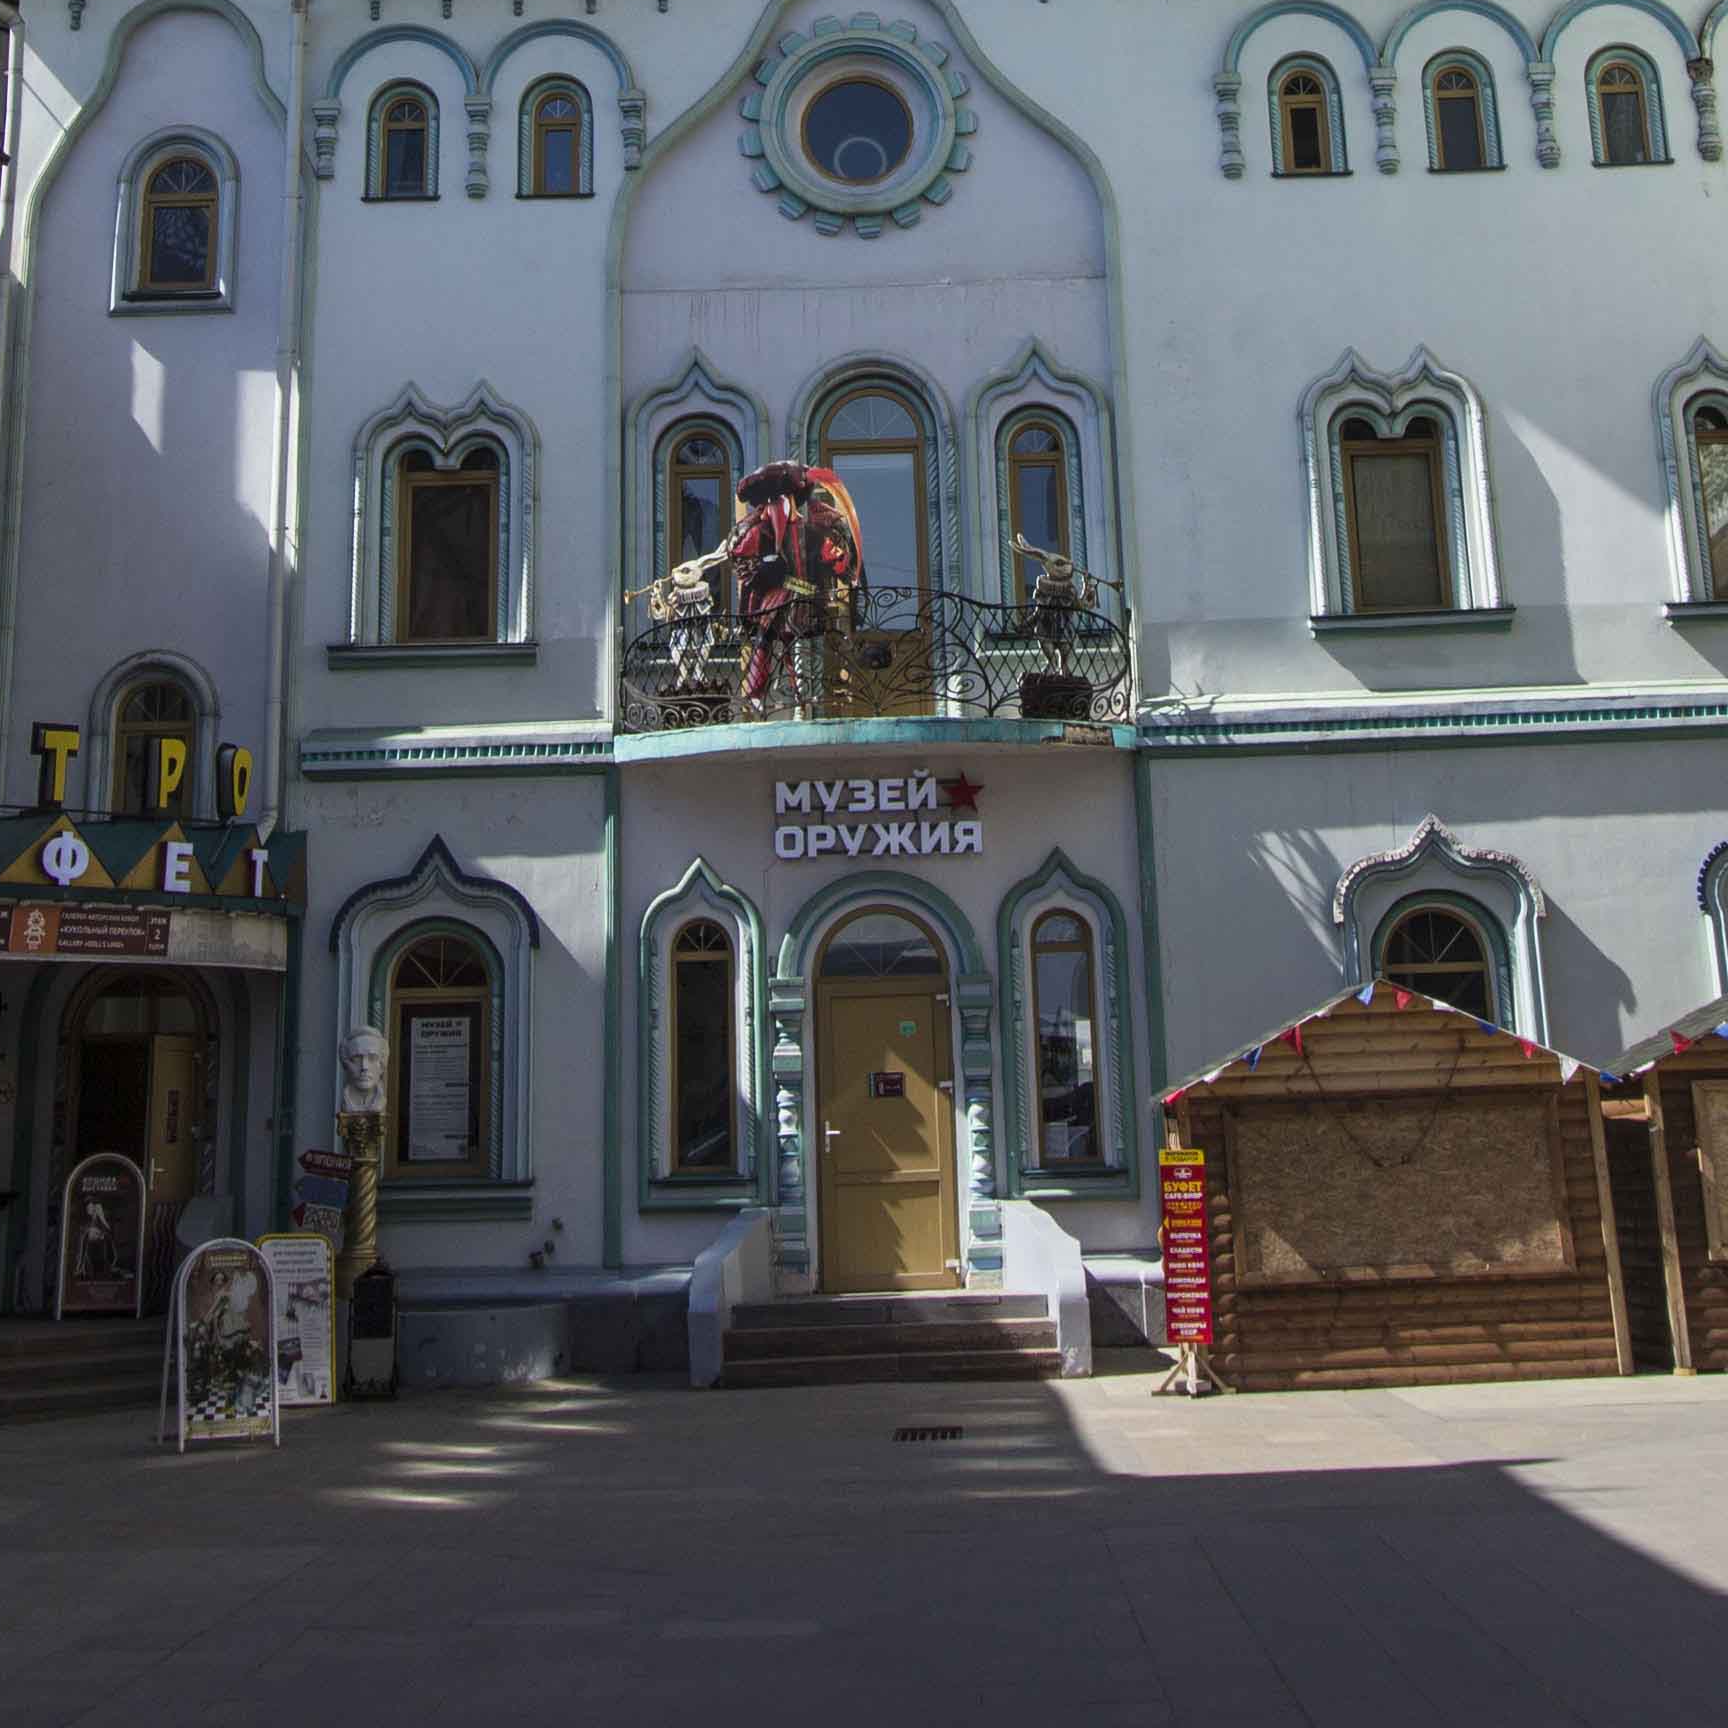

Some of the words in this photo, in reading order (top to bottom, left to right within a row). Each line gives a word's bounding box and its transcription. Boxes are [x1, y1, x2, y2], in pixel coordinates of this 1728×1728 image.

[775, 768, 938, 815] МУЗЕЙ
[775, 820, 983, 859] ОРУЖИЯ
[153, 928, 161, 941] 2
[1164, 1181, 1202, 1193] БУФЕТ
